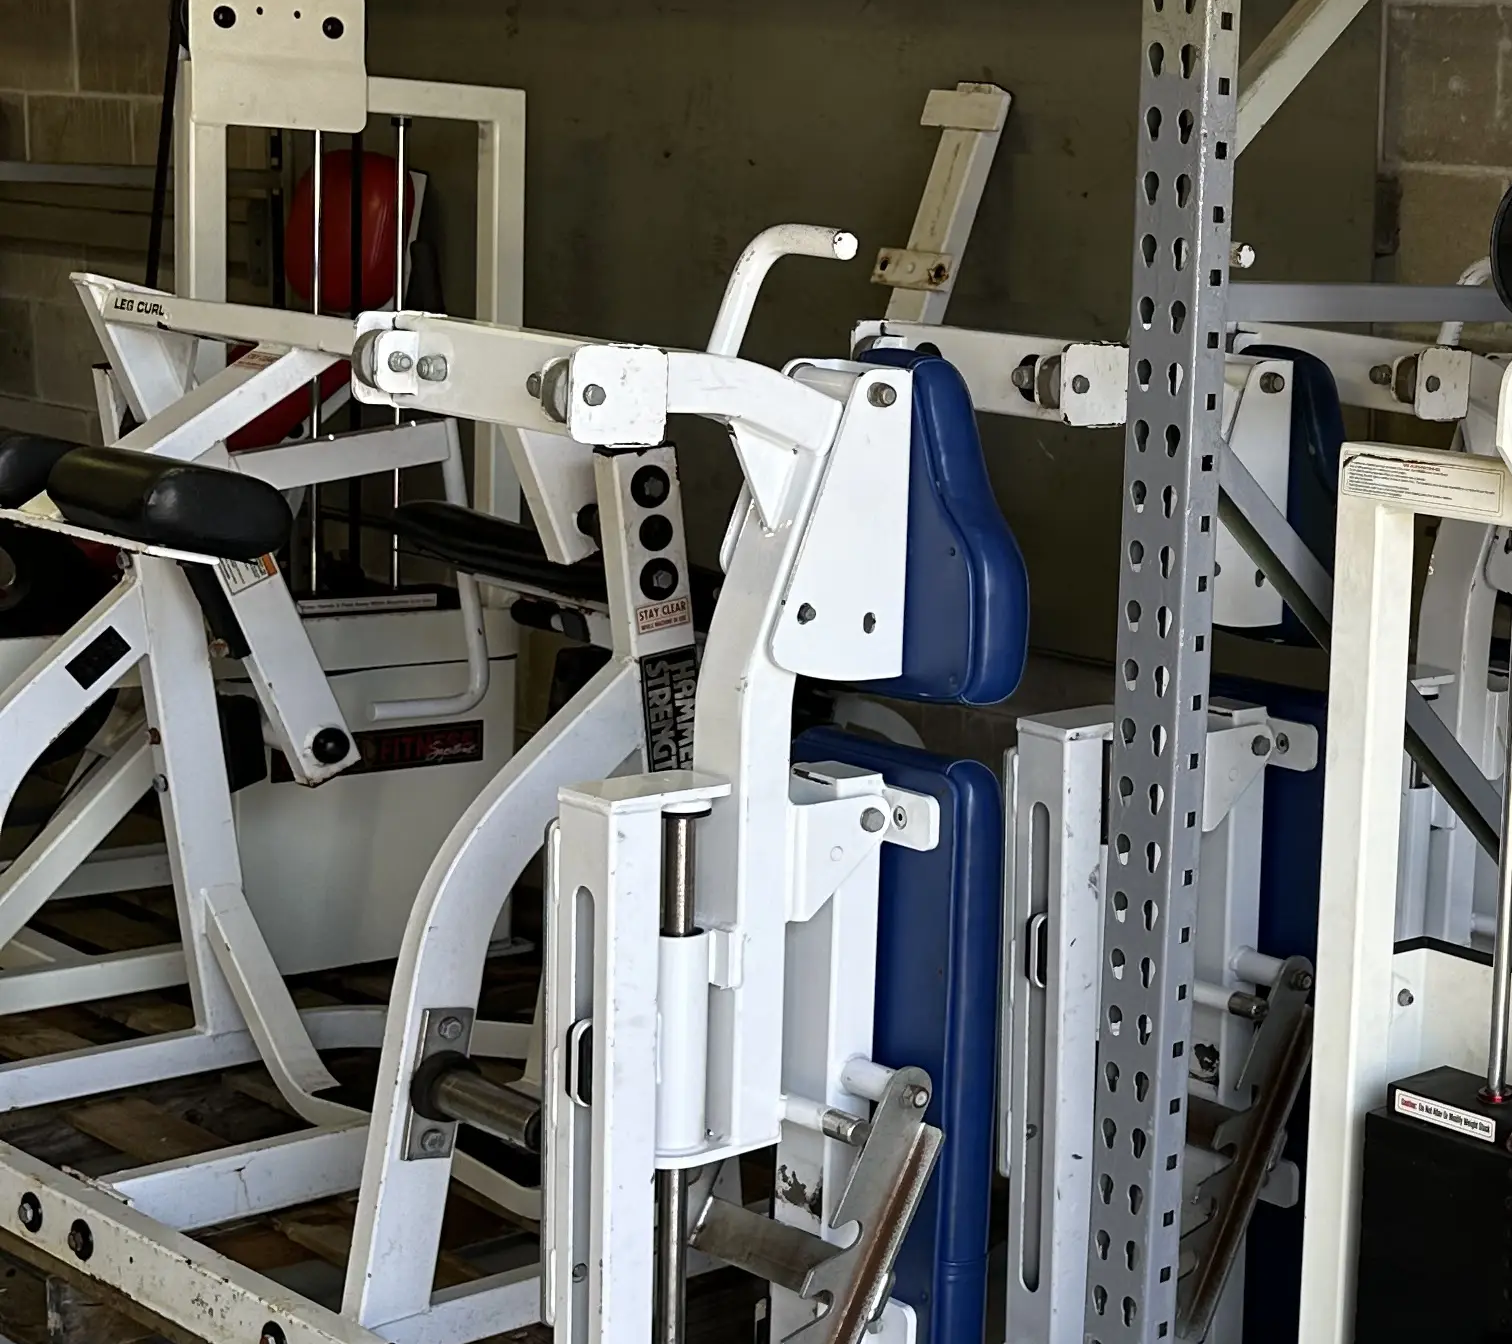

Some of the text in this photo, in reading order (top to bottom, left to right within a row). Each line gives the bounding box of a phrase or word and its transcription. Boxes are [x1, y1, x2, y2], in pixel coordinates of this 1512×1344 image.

[114, 297, 164, 316] LEG CURL
[640, 600, 686, 621] STAY CLEAR
[646, 660, 678, 770] STRENGT
